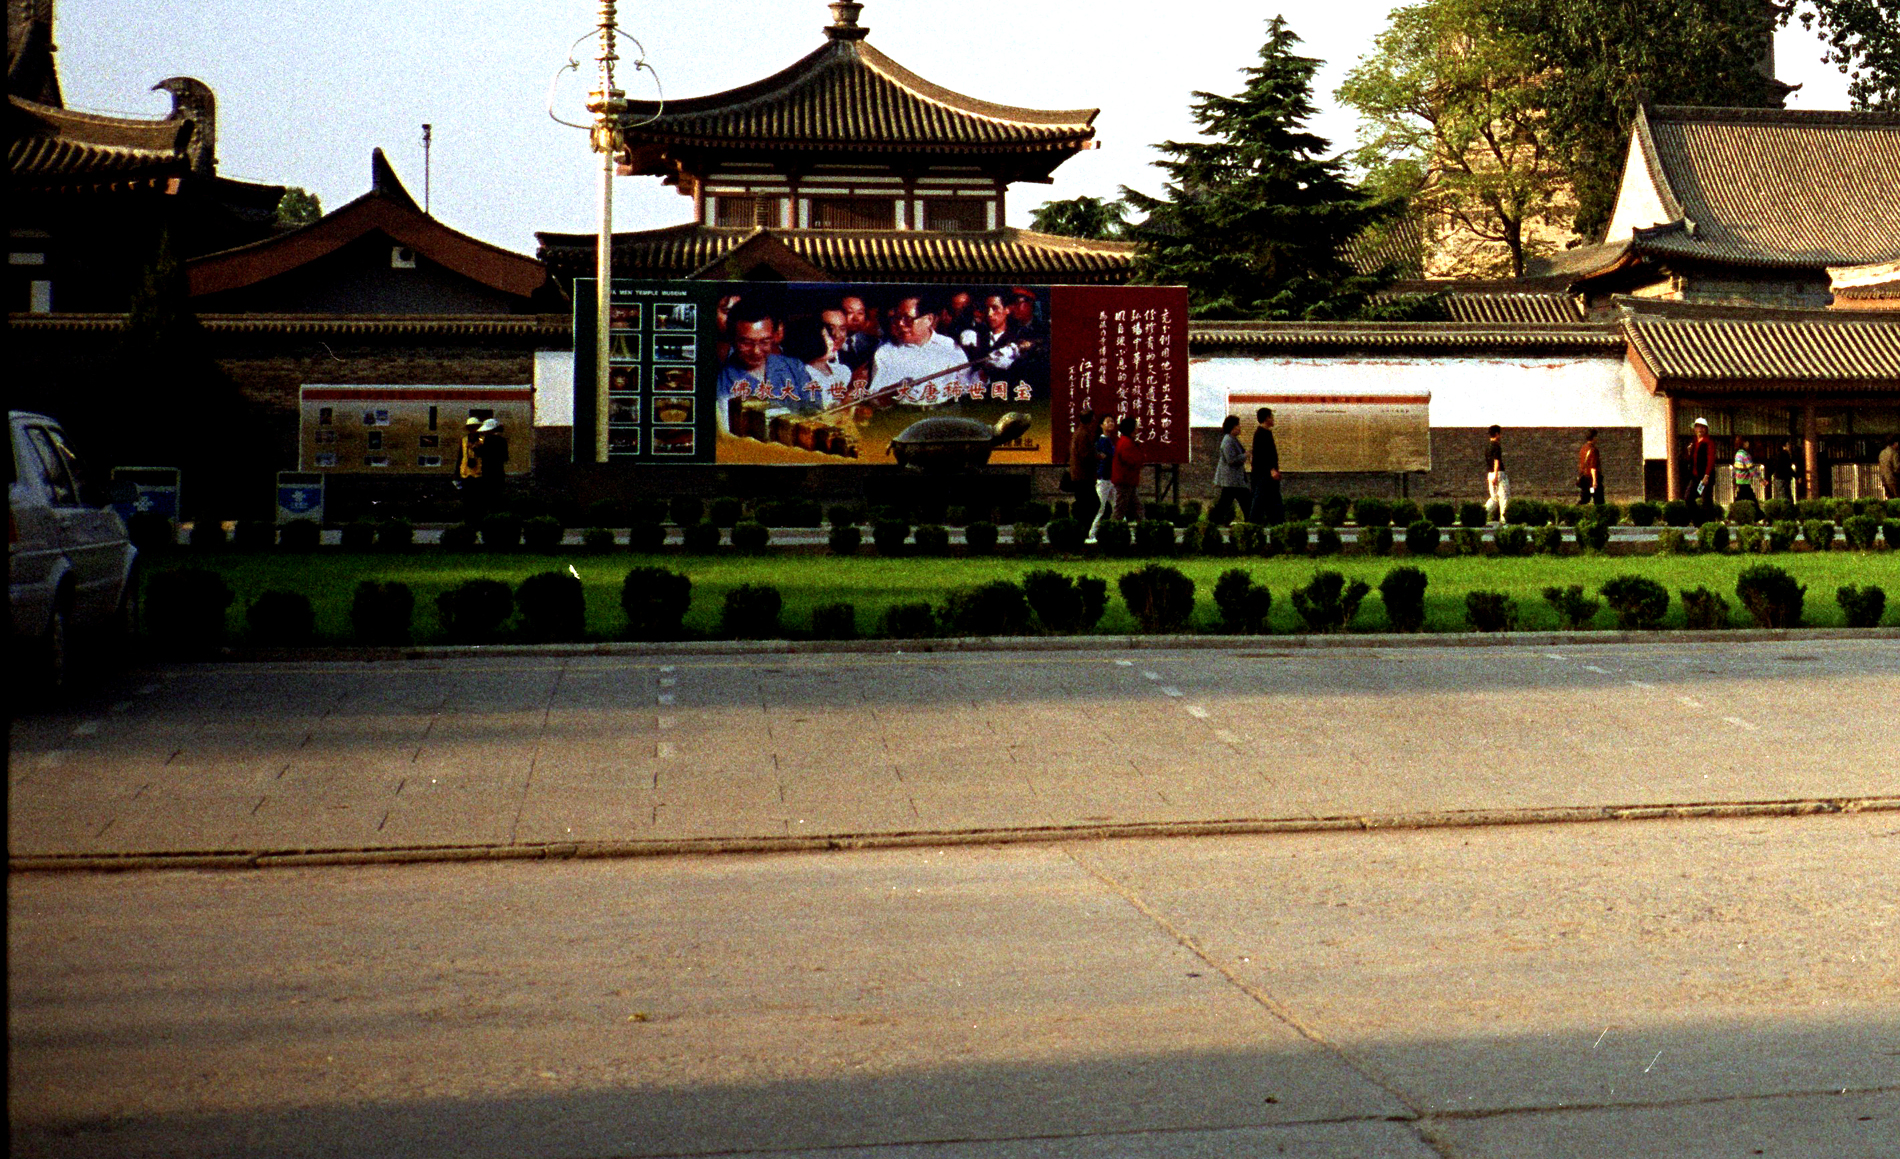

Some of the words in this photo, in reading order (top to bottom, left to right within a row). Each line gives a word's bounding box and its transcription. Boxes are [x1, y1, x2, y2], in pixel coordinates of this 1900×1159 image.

[730, 378, 870, 402] 佛教大千世界
[895, 379, 1033, 402] 大唐稀世国宝
